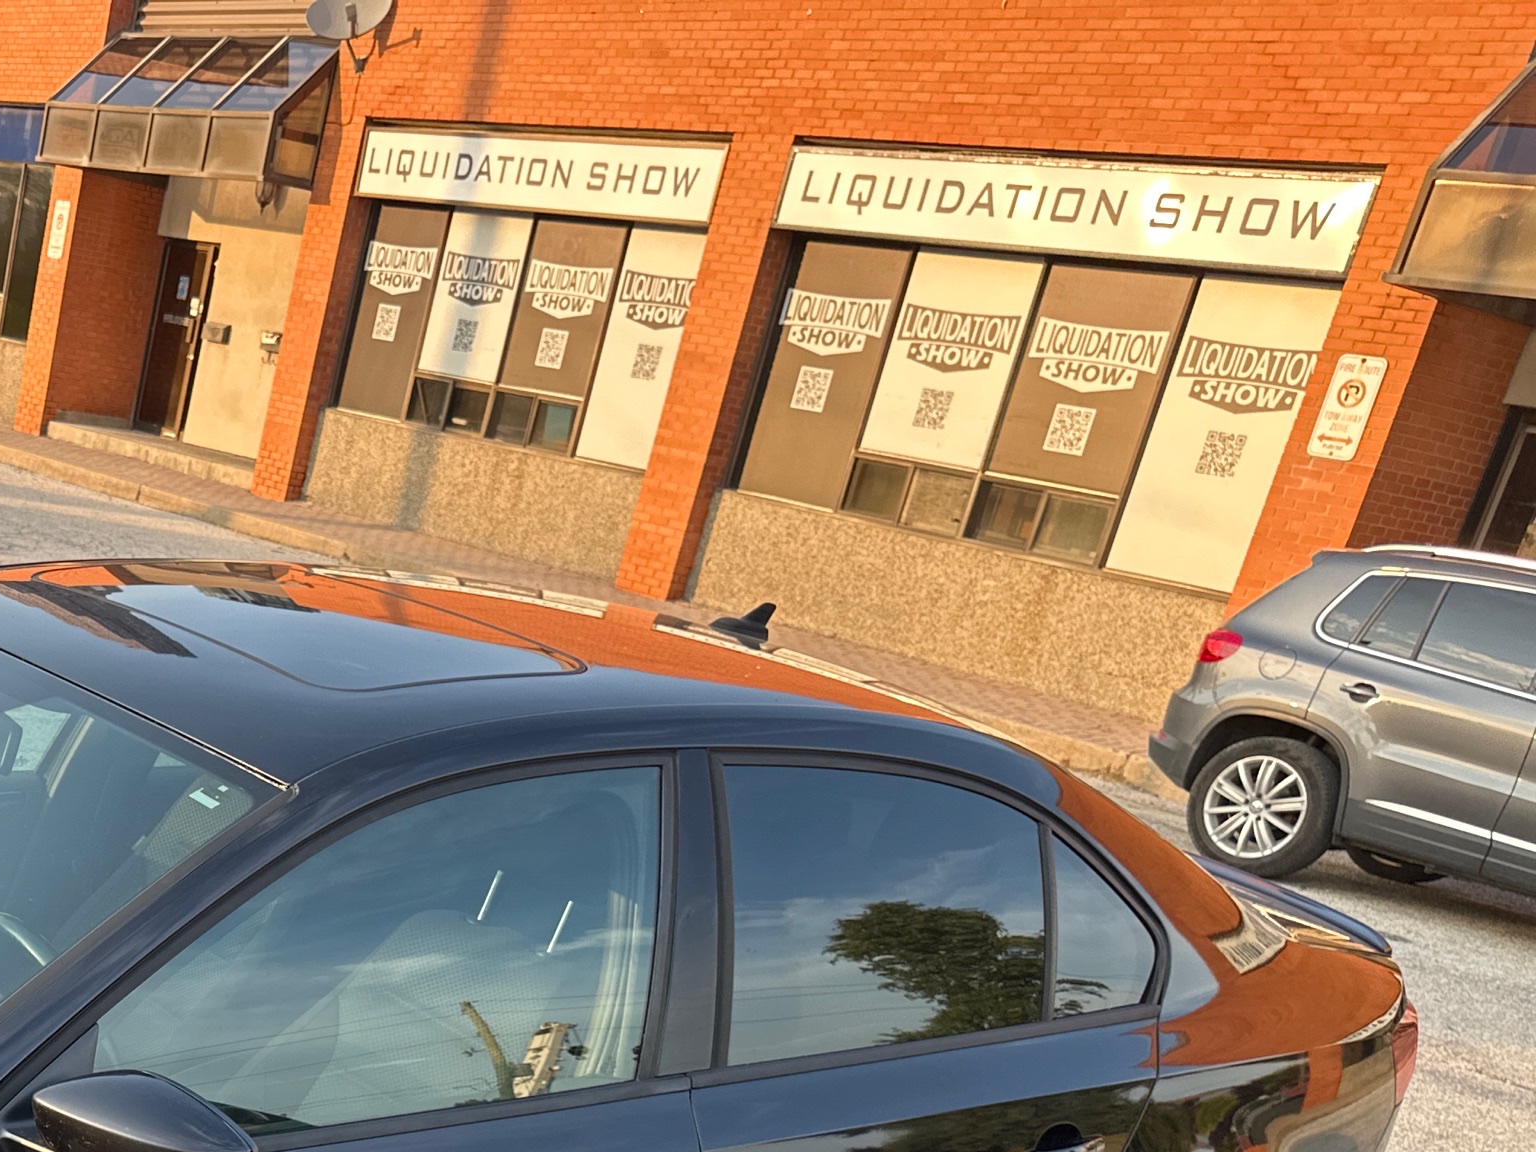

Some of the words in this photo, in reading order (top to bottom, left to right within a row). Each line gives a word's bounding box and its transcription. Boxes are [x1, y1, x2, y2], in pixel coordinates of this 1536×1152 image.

[367, 147, 574, 189] LIQUIDATION
[586, 161, 701, 198] SHOW
[800, 169, 1129, 227] LIQUIDATION
[1148, 192, 1337, 241] SHOW
[368, 245, 434, 275] LIQUIDATION
[446, 253, 519, 287] LIQUIDATION
[376, 272, 415, 289] SHOW
[454, 282, 498, 302] SHOW
[529, 263, 610, 298] LIQUIDATION
[539, 293, 587, 313] SHOW
[633, 304, 686, 326] SHOW
[785, 294, 886, 333] LIQUIDATION
[796, 327, 856, 349] SHOW
[901, 306, 1018, 351] LIQUIDATION
[917, 343, 985, 368] SHOW
[1035, 321, 1163, 368] LIQUIDATION
[1051, 361, 1126, 386] SHOW
[1339, 362, 1357, 374] FIRE
[1200, 380, 1286, 409] SHOW
[1324, 410, 1341, 421] TOW
[1329, 422, 1350, 433] ZONE
